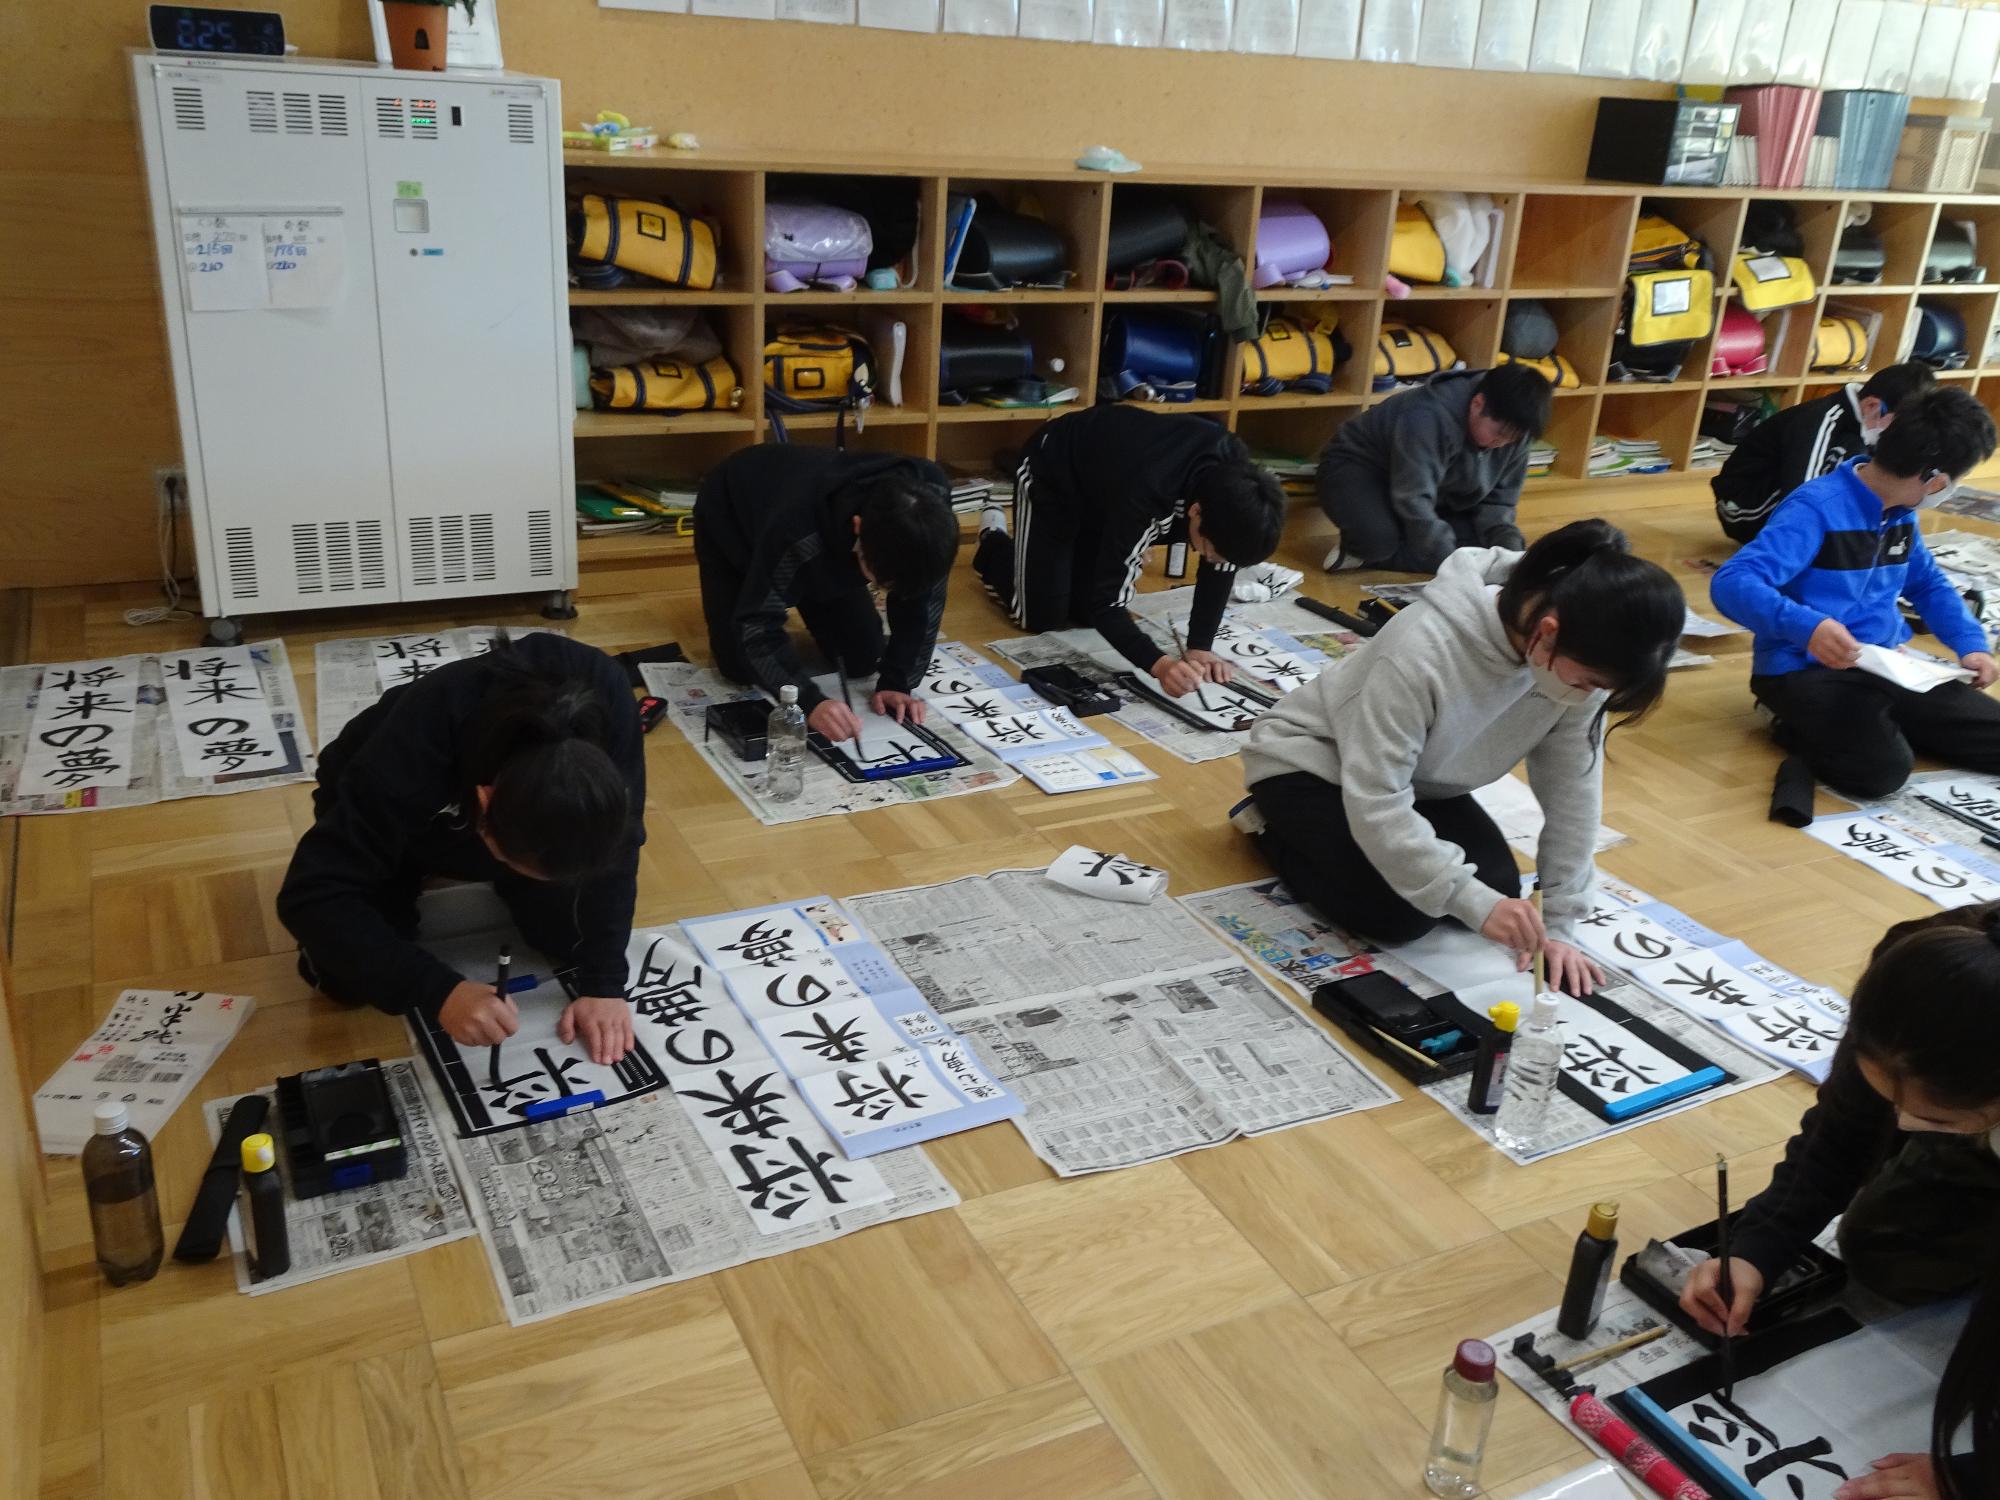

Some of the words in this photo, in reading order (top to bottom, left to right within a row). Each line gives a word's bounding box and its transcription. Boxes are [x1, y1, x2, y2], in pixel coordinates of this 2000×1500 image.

[40, 666, 133, 788] 将来の夢
[160, 656, 274, 773] 将来の夢
[717, 918, 930, 1121] 将来の夢
